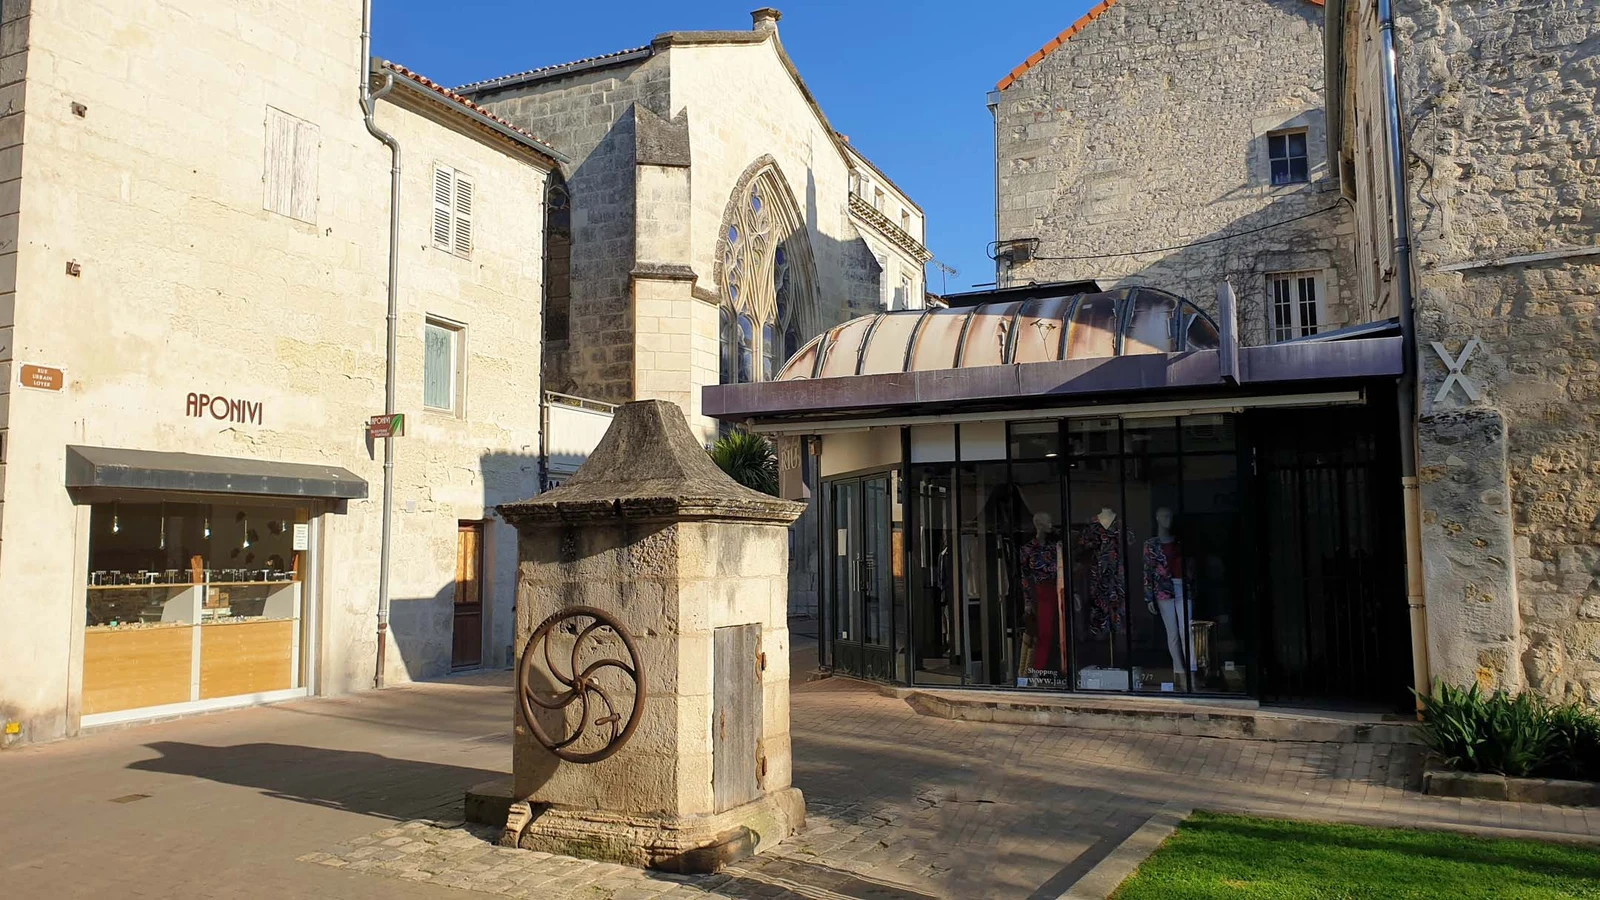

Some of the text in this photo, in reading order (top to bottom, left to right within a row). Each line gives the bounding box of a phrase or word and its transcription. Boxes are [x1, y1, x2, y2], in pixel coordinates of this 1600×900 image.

[32, 373, 53, 381] URBAIN
[186, 392, 263, 426] APONIVI
[1027, 667, 1058, 677] Shopping
